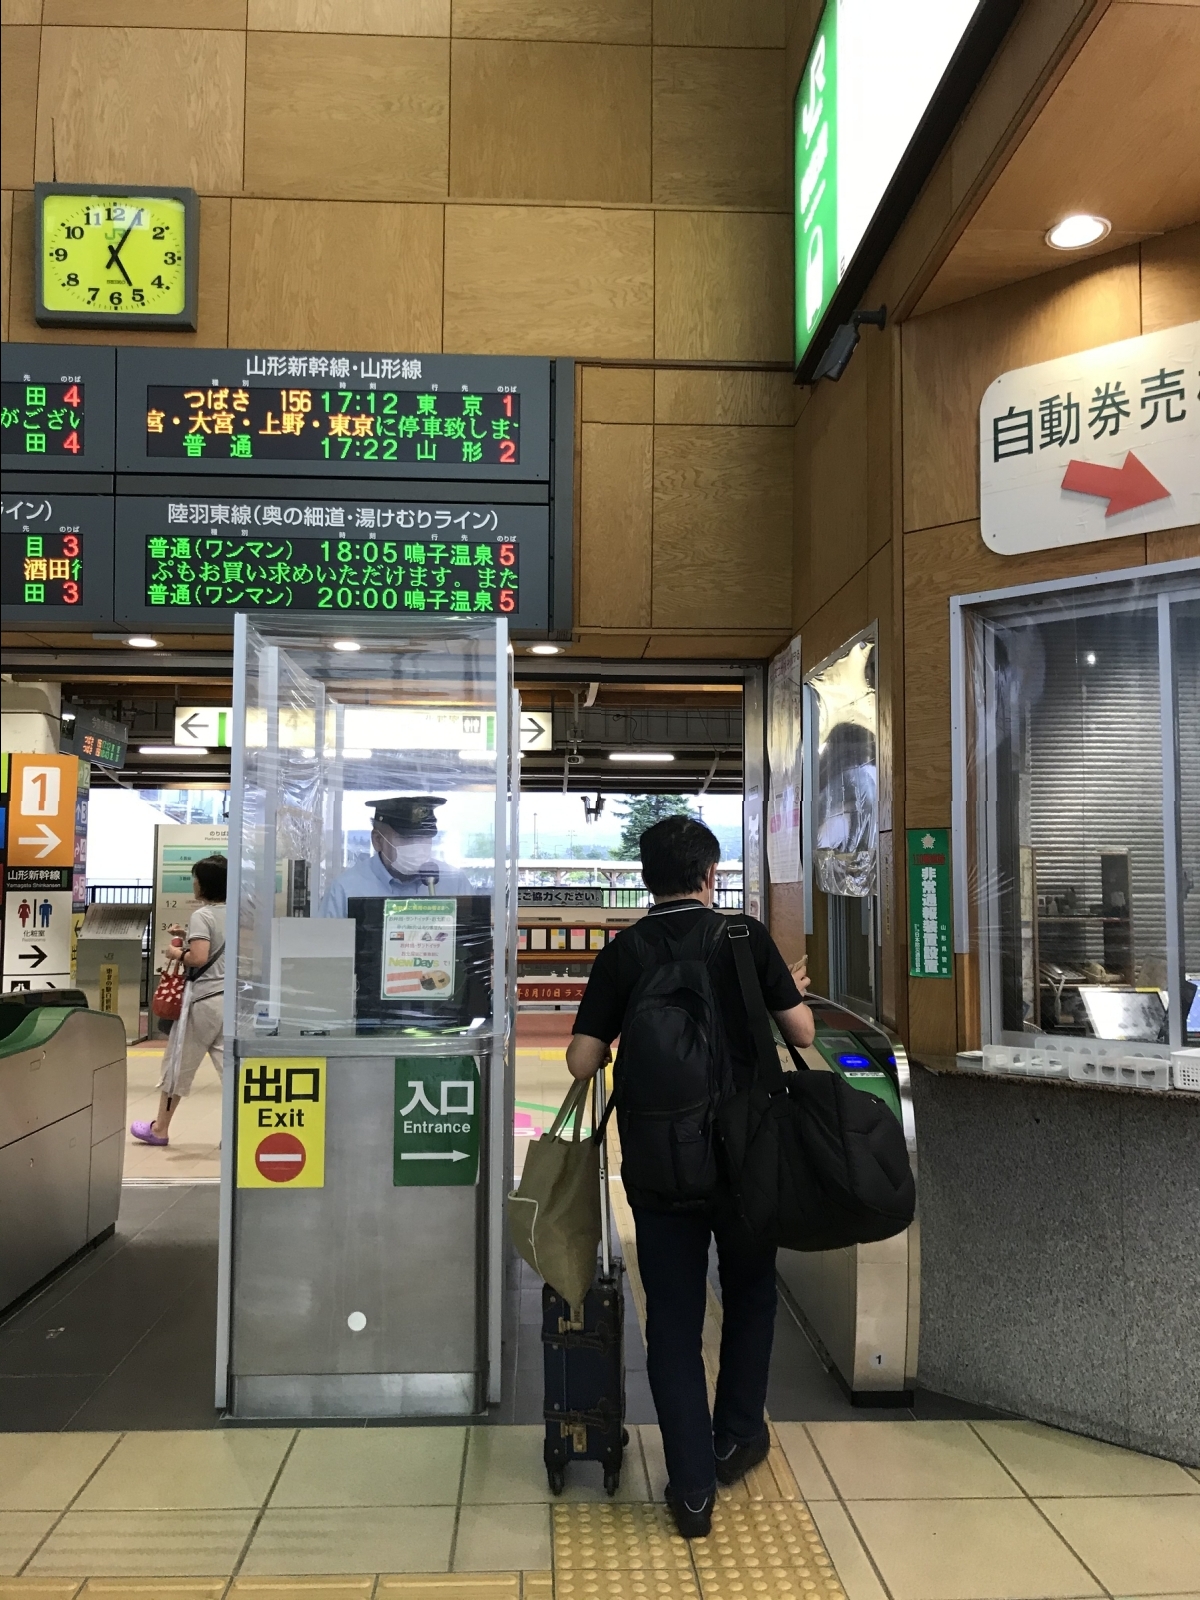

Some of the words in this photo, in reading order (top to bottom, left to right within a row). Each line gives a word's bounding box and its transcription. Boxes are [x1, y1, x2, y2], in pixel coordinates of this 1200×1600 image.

[84, 212, 102, 226] 11
[105, 207, 125, 221] 12
[65, 226, 85, 240] 10
[152, 226, 165, 240] 2
[54, 248, 68, 262] 9
[163, 251, 177, 265] 3
[66, 273, 80, 287] 8
[151, 275, 164, 289] 4
[88, 287, 100, 301] 7
[109, 291, 123, 306] 6
[132, 288, 145, 303] 5
[246, 355, 423, 380] 山形新幹線・山形線
[60, 375, 81, 383] のりば
[26, 386, 46, 407] 田
[63, 385, 81, 408] 4
[497, 385, 517, 393] のりば
[184, 388, 250, 412] つばさ
[280, 389, 312, 413] 156
[321, 391, 398, 415] 17:12
[502, 394, 513, 418] 1
[993, 367, 1200, 463] 自動券売
[148, 410, 519, 440] 宮・大宮・上野・東京に停車致しま
[26, 433, 46, 453] 田
[63, 431, 81, 454] 4
[321, 437, 398, 461] 17:22
[499, 440, 516, 464] 2
[27, 535, 43, 558] 目
[62, 535, 80, 558] 3
[496, 535, 517, 543] のりば
[320, 540, 398, 564] 18:05
[404, 542, 494, 567] 鳴子温泉
[499, 543, 516, 567] 5
[25, 583, 45, 604] 田
[62, 581, 80, 605] 3
[317, 586, 398, 610] 20:00
[404, 588, 494, 612] 鳴子温泉
[499, 590, 516, 613] 5
[31, 773, 48, 811] 1
[7, 870, 61, 881] 山形新幹線
[388, 957, 440, 969] NewDays
[243, 1065, 321, 1104] 出口
[399, 1080, 475, 1117] 入口
[258, 1108, 305, 1128] Exit
[403, 1120, 471, 1134] Entrance
[875, 1354, 882, 1365] 1
